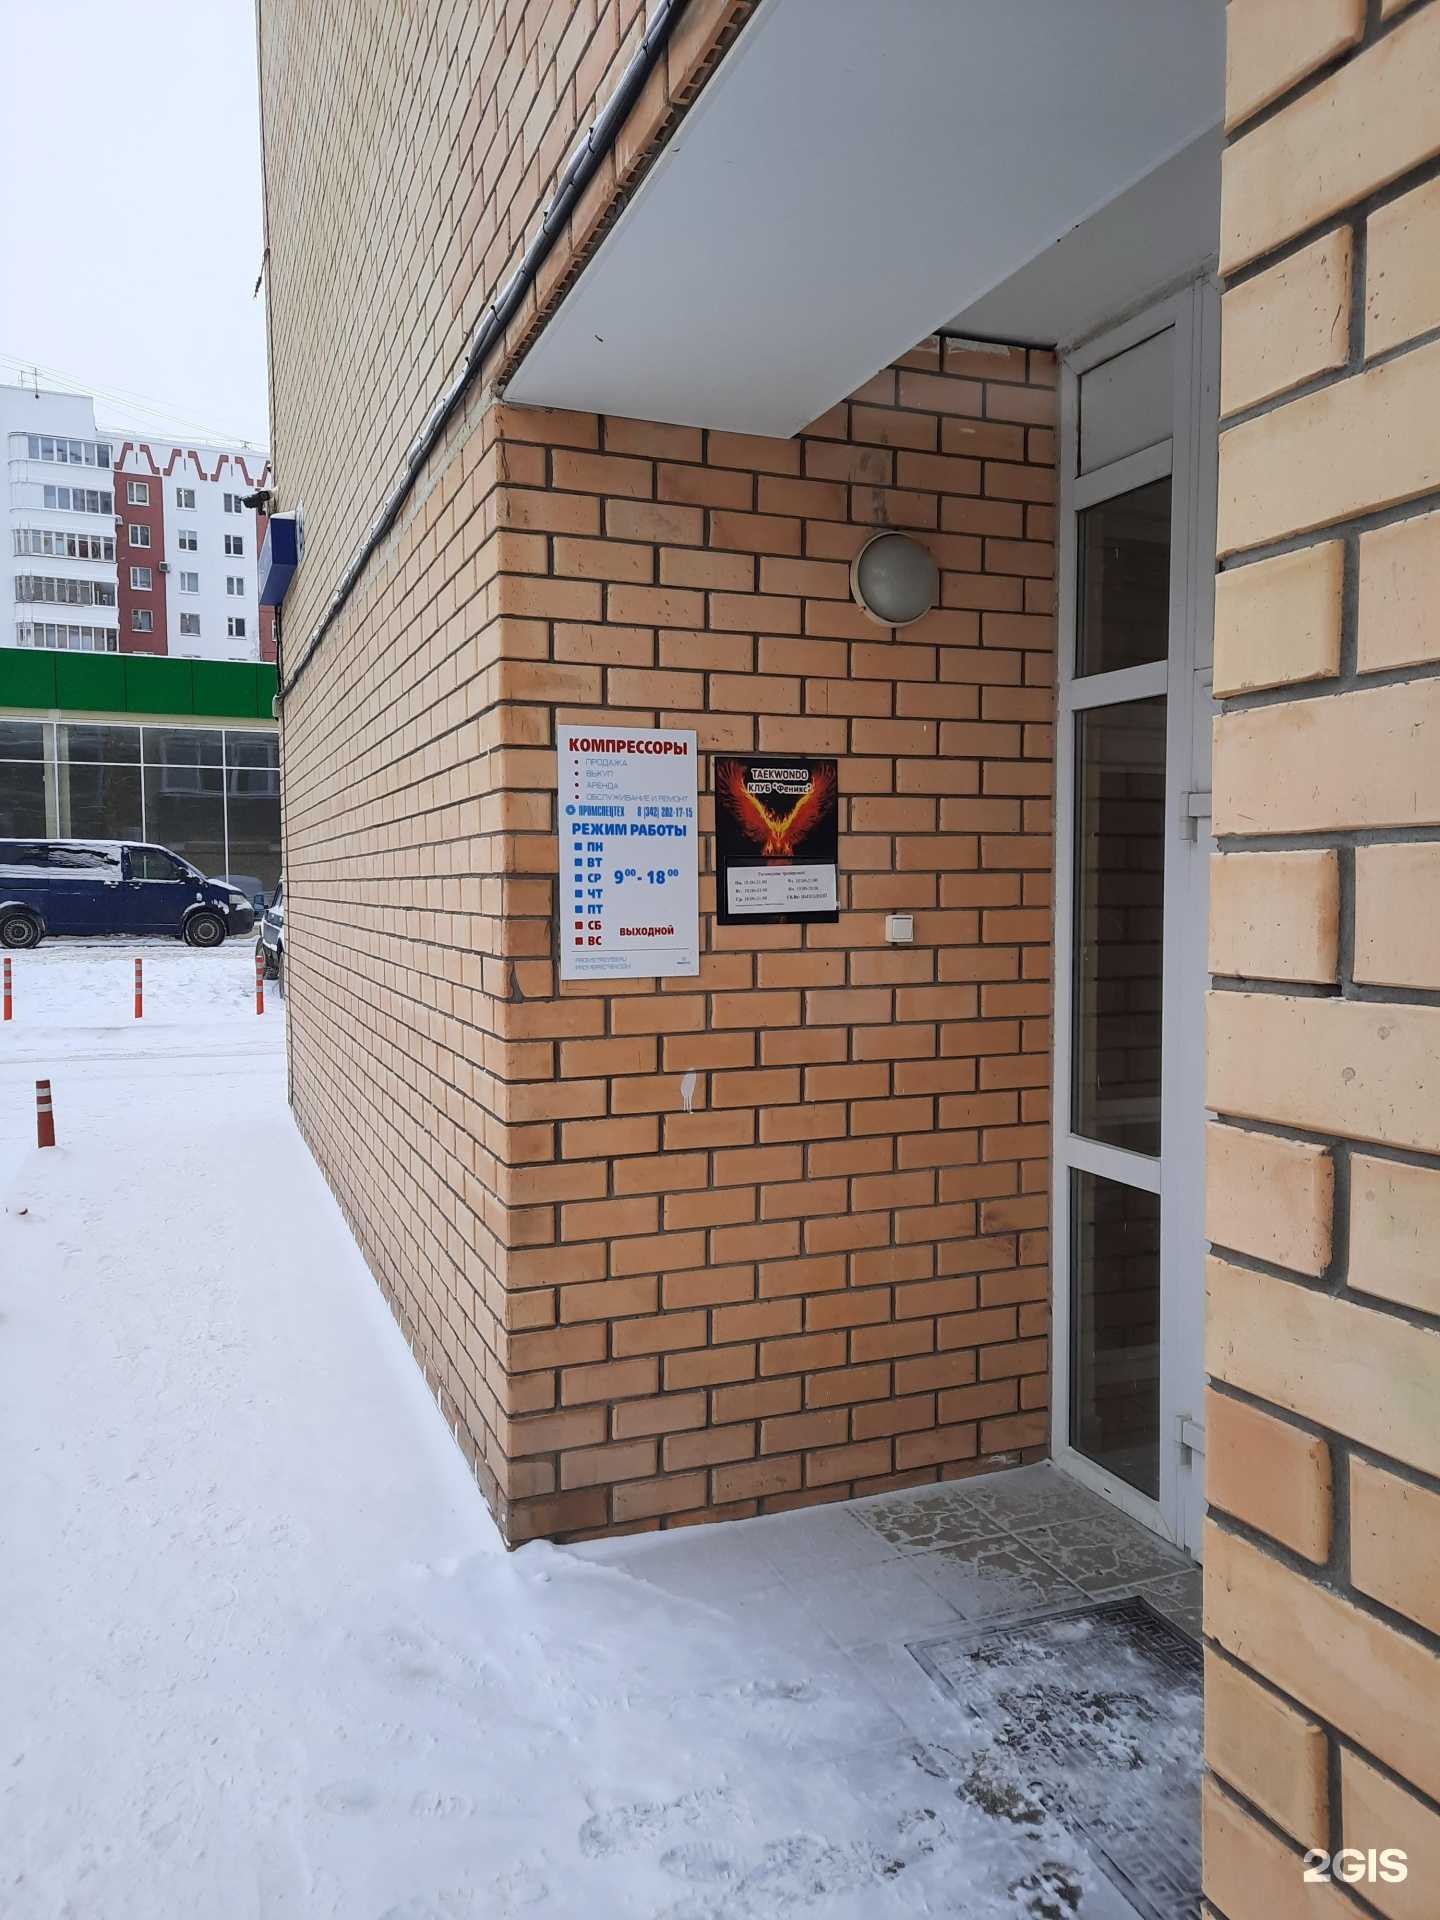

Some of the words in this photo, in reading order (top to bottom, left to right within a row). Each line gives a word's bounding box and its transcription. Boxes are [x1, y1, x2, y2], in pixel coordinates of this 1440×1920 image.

[569, 738, 688, 755] КОМПРЕССОРЫ
[585, 758, 628, 767] ПРОДАЖА
[585, 770, 614, 778] ВЫКУП
[752, 769, 808, 780] TAEKWONDO
[586, 782, 619, 790] АРЕНДА
[748, 783, 771, 793] КЛУБ
[578, 805, 625, 818] ПРОМСПЕЦТЕХ
[572, 823, 627, 836] РЕЖИМ
[630, 824, 687, 837] РАБОТЫ
[587, 842, 603, 852] ПН
[587, 858, 603, 867] ВТ
[587, 873, 602, 883] СР
[587, 889, 603, 898] ЧТ
[587, 904, 603, 914] ПТ
[588, 921, 602, 930] СБ
[619, 925, 674, 937] ВЫХОДНОЙ
[588, 936, 602, 945] ВС
